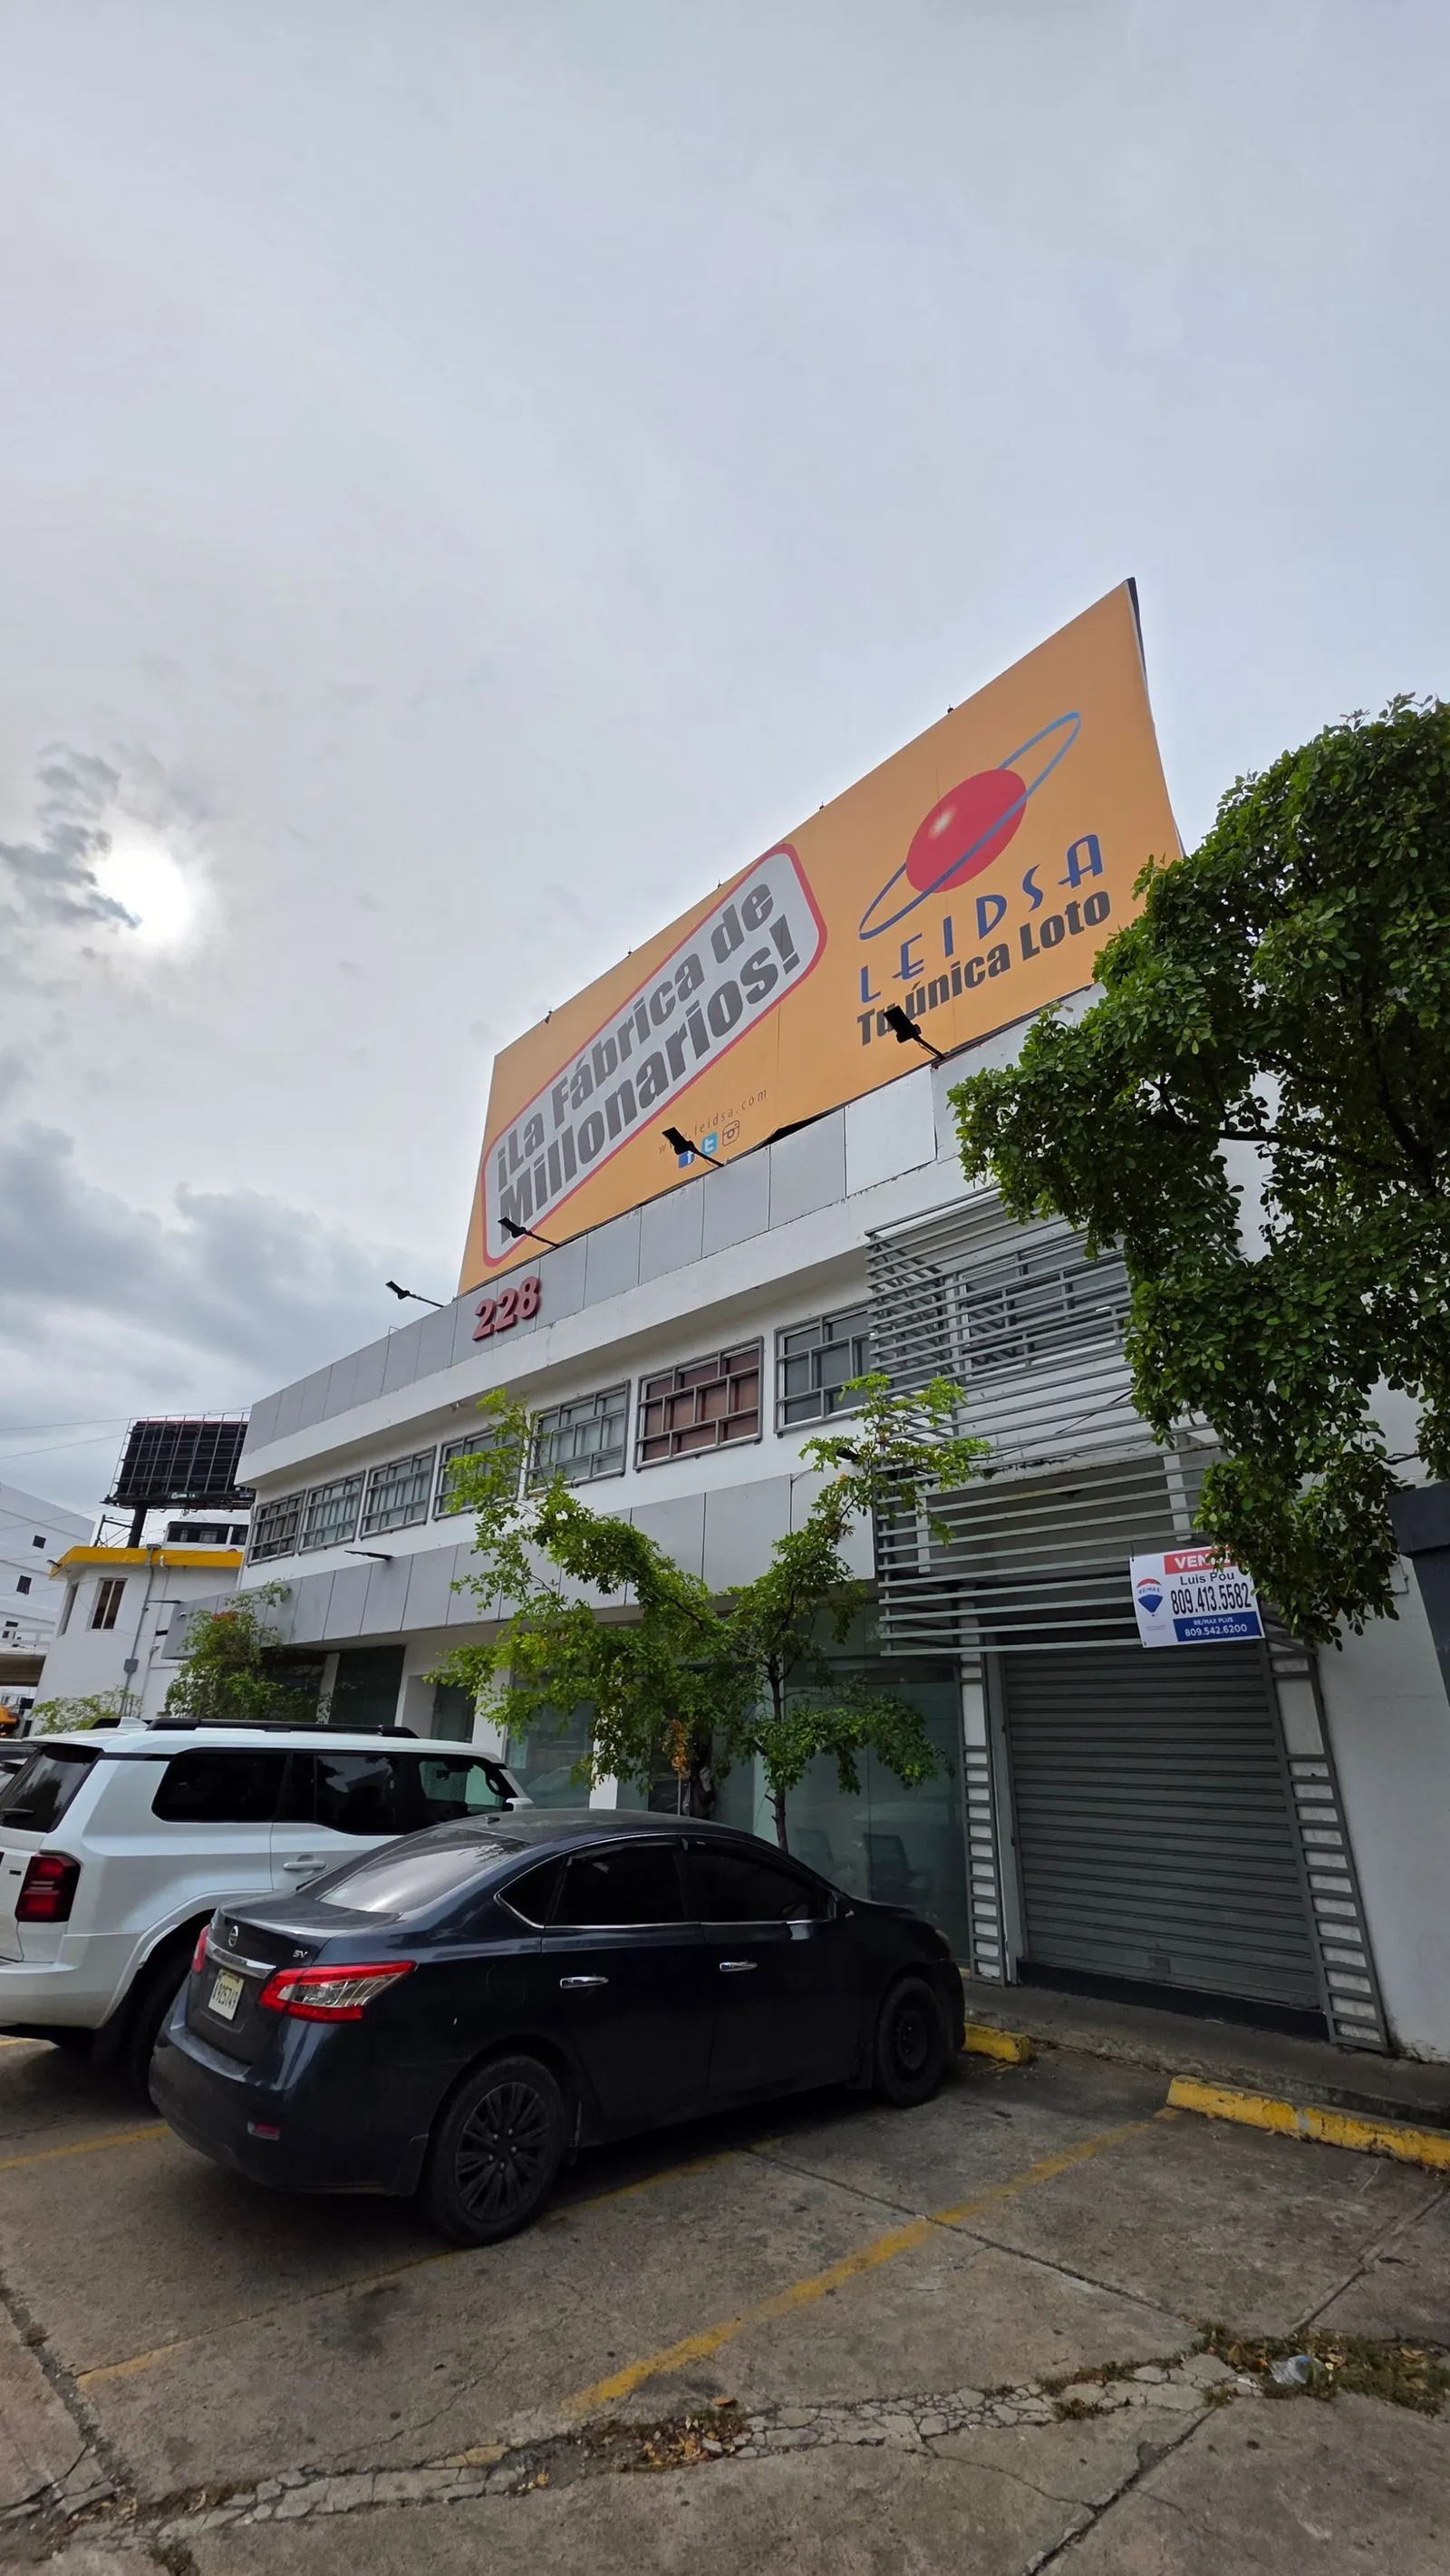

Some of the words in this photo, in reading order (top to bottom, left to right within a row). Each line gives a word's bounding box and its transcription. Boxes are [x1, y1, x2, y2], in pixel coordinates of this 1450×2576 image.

[860, 834, 1104, 1003] LEIDSA
[904, 943, 1011, 1021] única
[1019, 891, 1112, 962] Loto
[551, 950, 705, 1128] Fábrica
[710, 883, 774, 964] de
[498, 913, 801, 1245] Millonarios!
[658, 1089, 768, 1155] w.leidsa.com
[472, 1275, 541, 1341] 228
[1170, 1582, 1252, 1615] 809.413.5582
[1180, 1574, 1206, 1586] Luis
[1210, 1572, 1235, 1583] Pou
[1184, 1623, 1248, 1637] 809.542.6200
[1218, 1616, 1233, 1624] PLUS
[293, 1949, 308, 1959] SV
